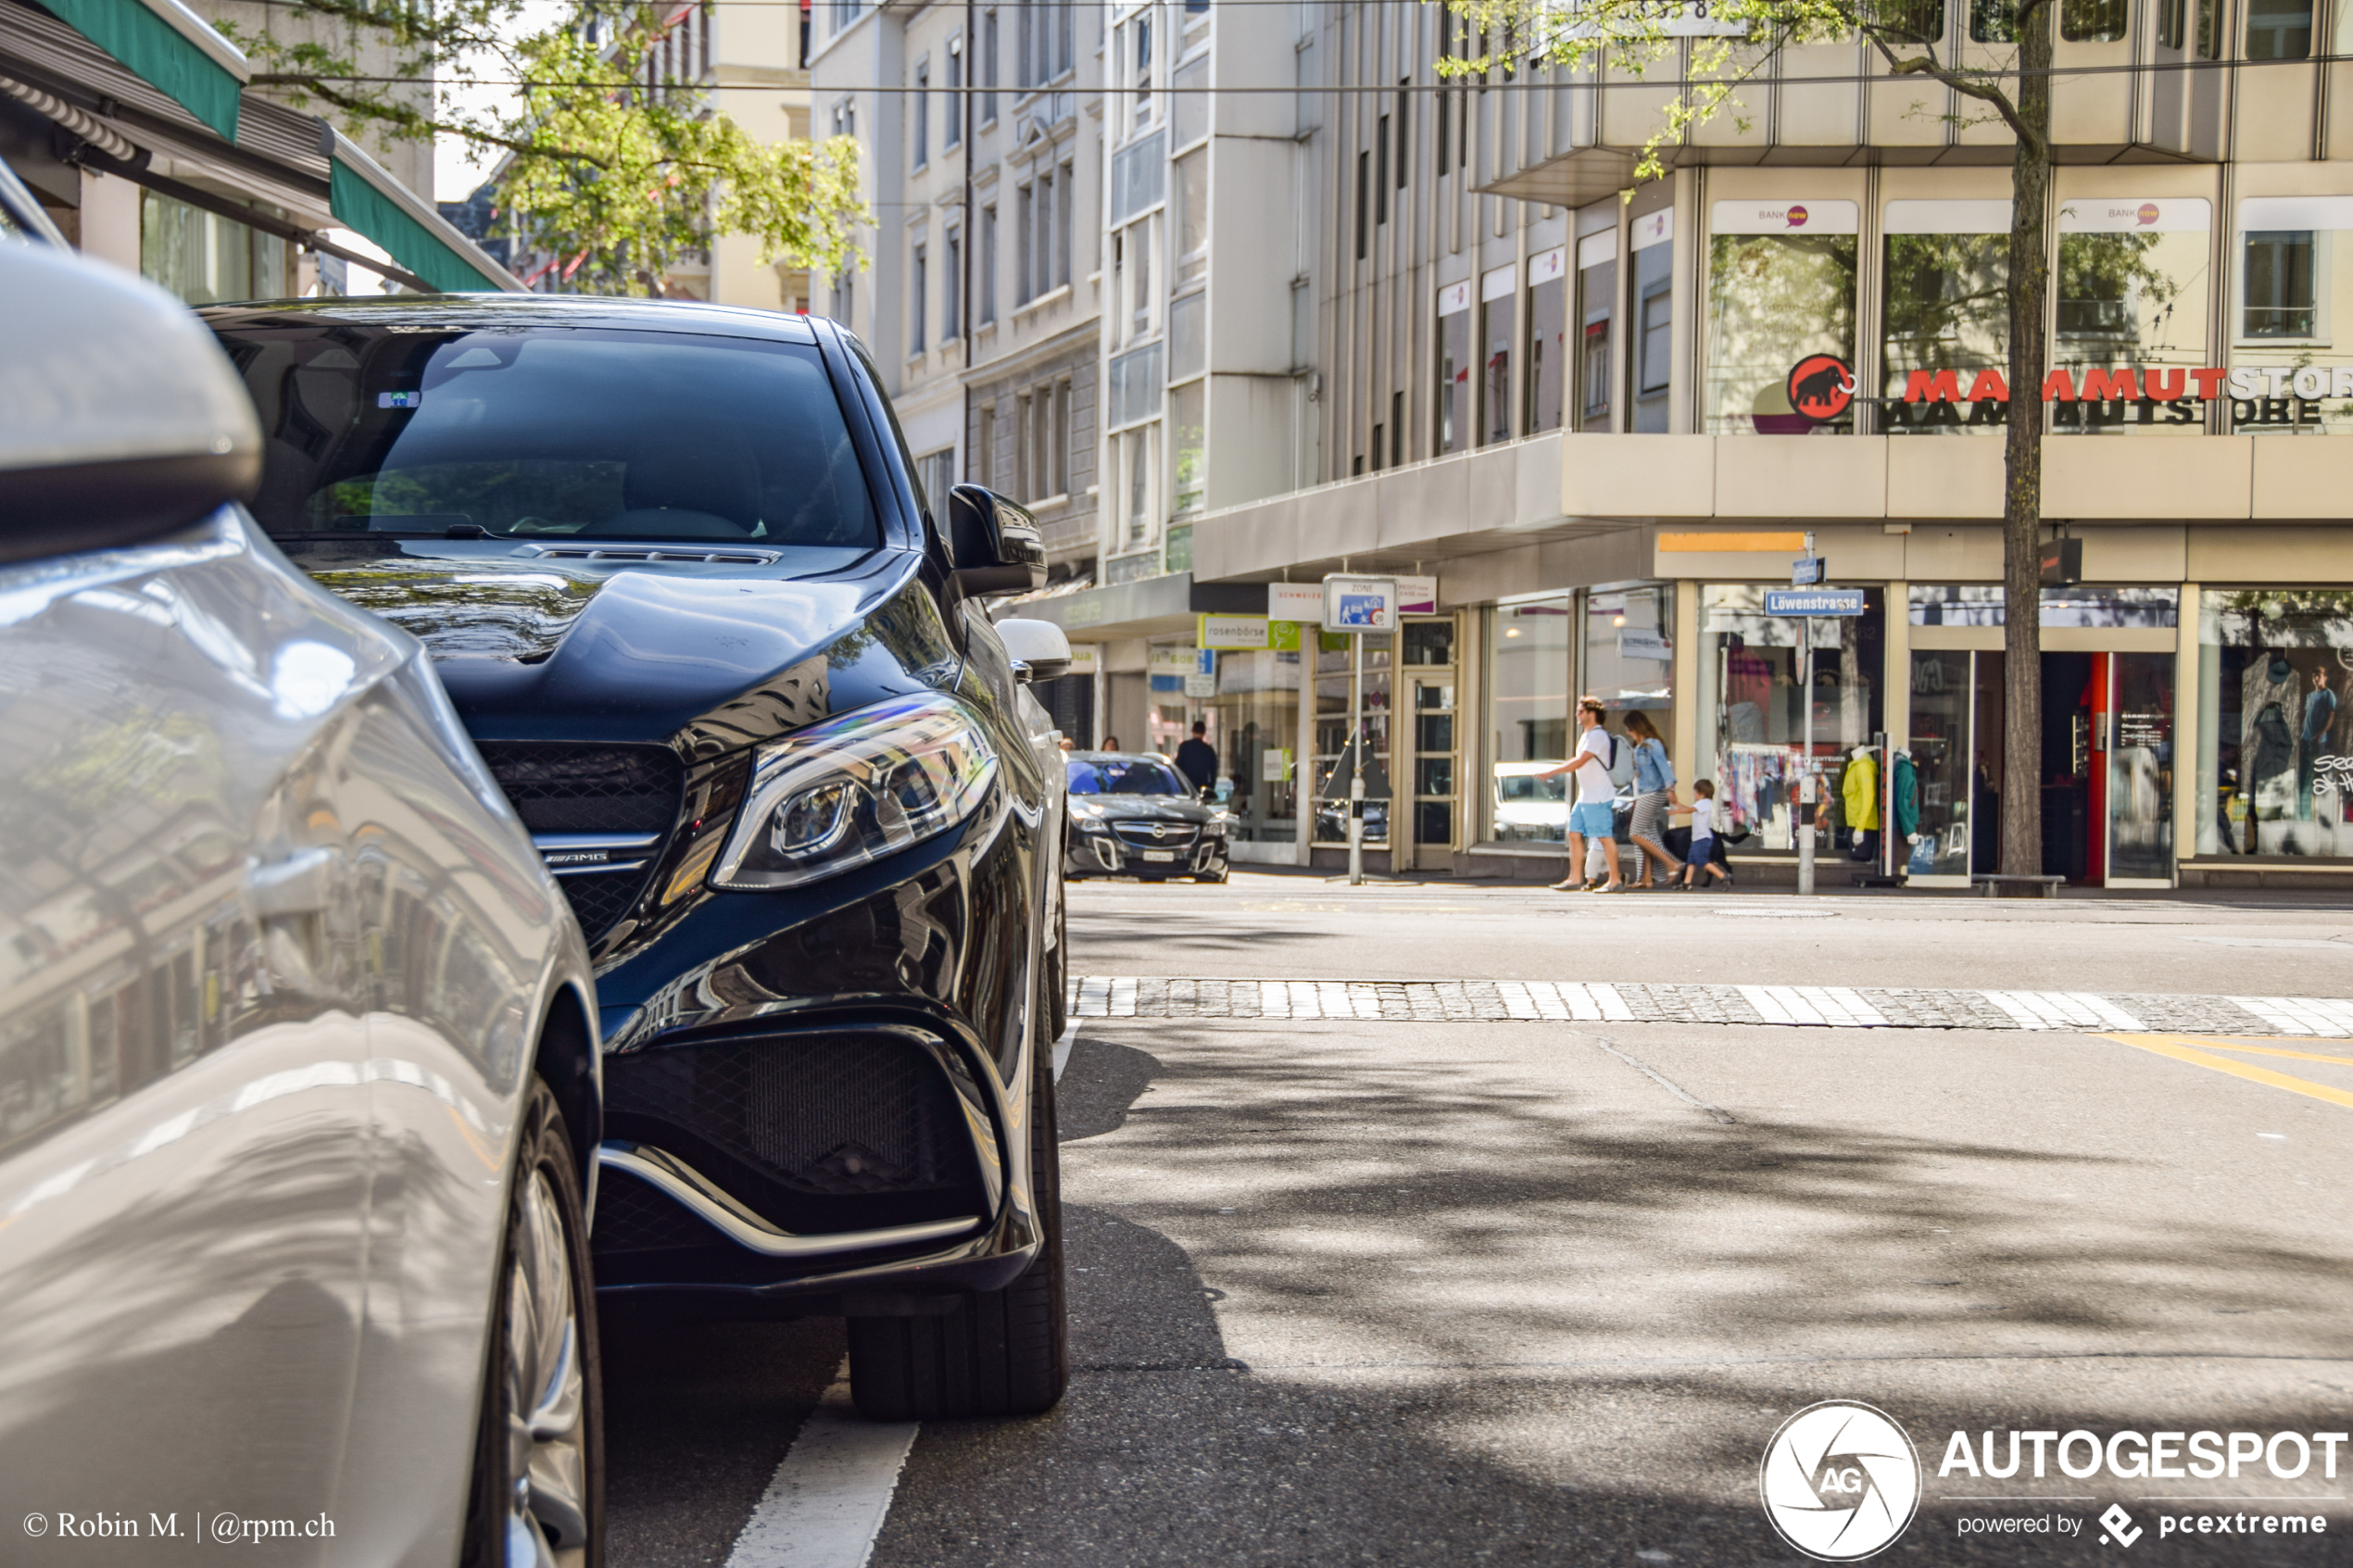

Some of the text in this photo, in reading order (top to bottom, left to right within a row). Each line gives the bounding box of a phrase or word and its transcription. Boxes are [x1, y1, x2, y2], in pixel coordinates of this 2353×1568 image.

[1759, 211, 1786, 220] BANK
[2108, 209, 2136, 218] BANK
[1353, 584, 1373, 593] ZONE
[1770, 596, 1857, 610] Löwenstrasse
[1209, 626, 1265, 637] rosenbörse
[565, 853, 608, 862] AMG
